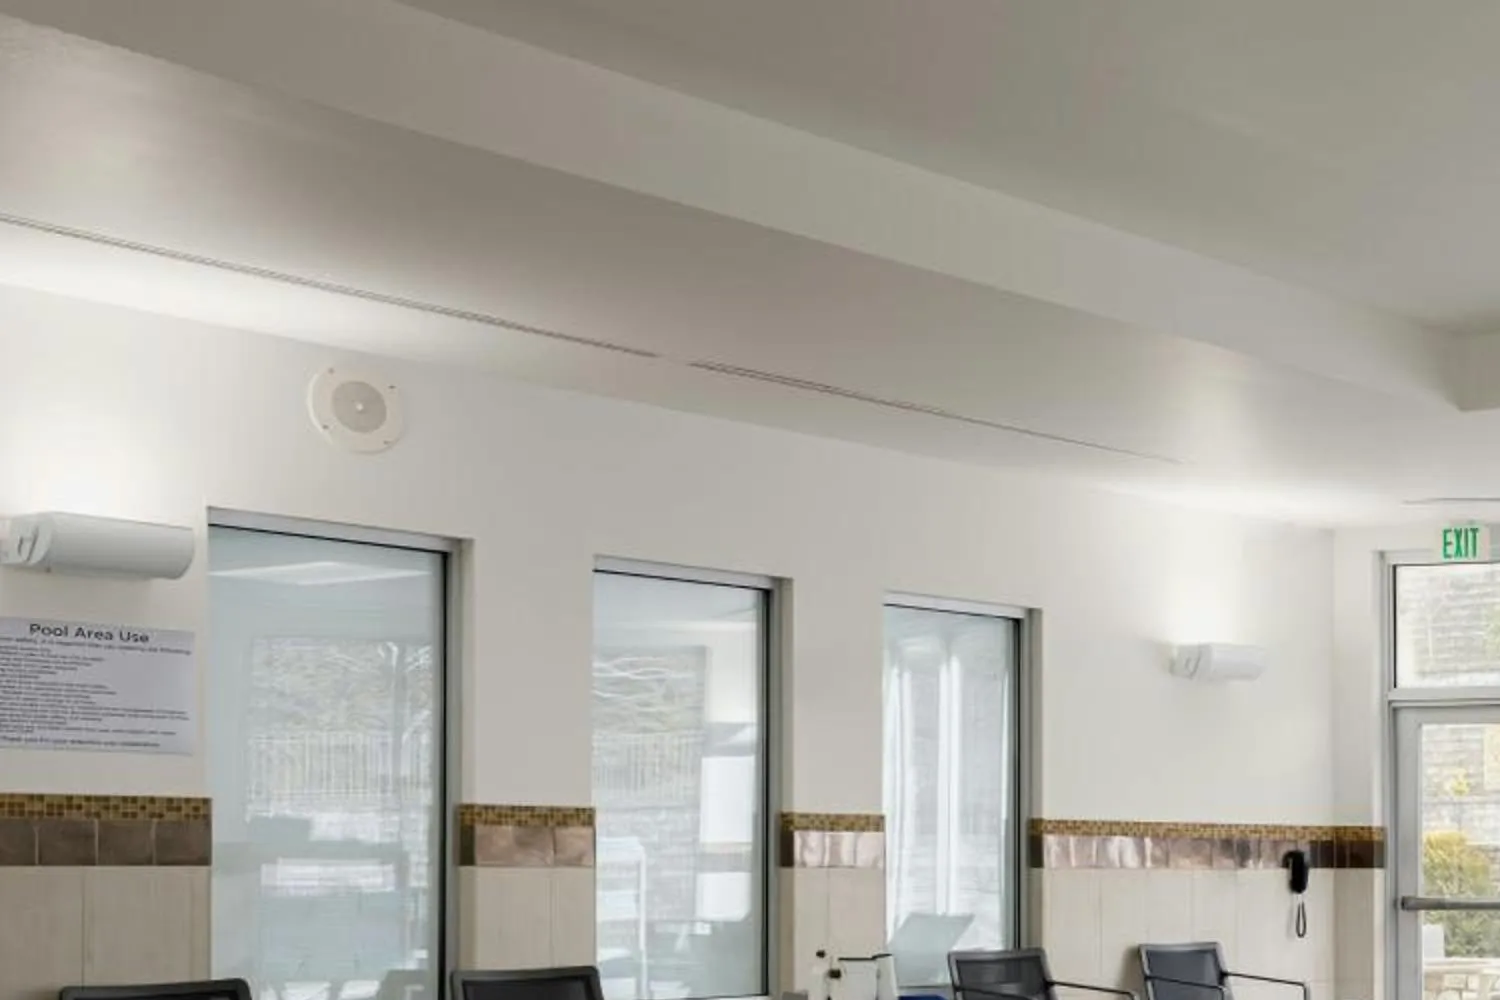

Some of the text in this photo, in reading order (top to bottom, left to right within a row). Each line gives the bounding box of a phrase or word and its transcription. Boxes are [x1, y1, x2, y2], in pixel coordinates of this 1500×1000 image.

[1442, 527, 1479, 559] EXIT
[29, 623, 150, 643] Pool Area Use
